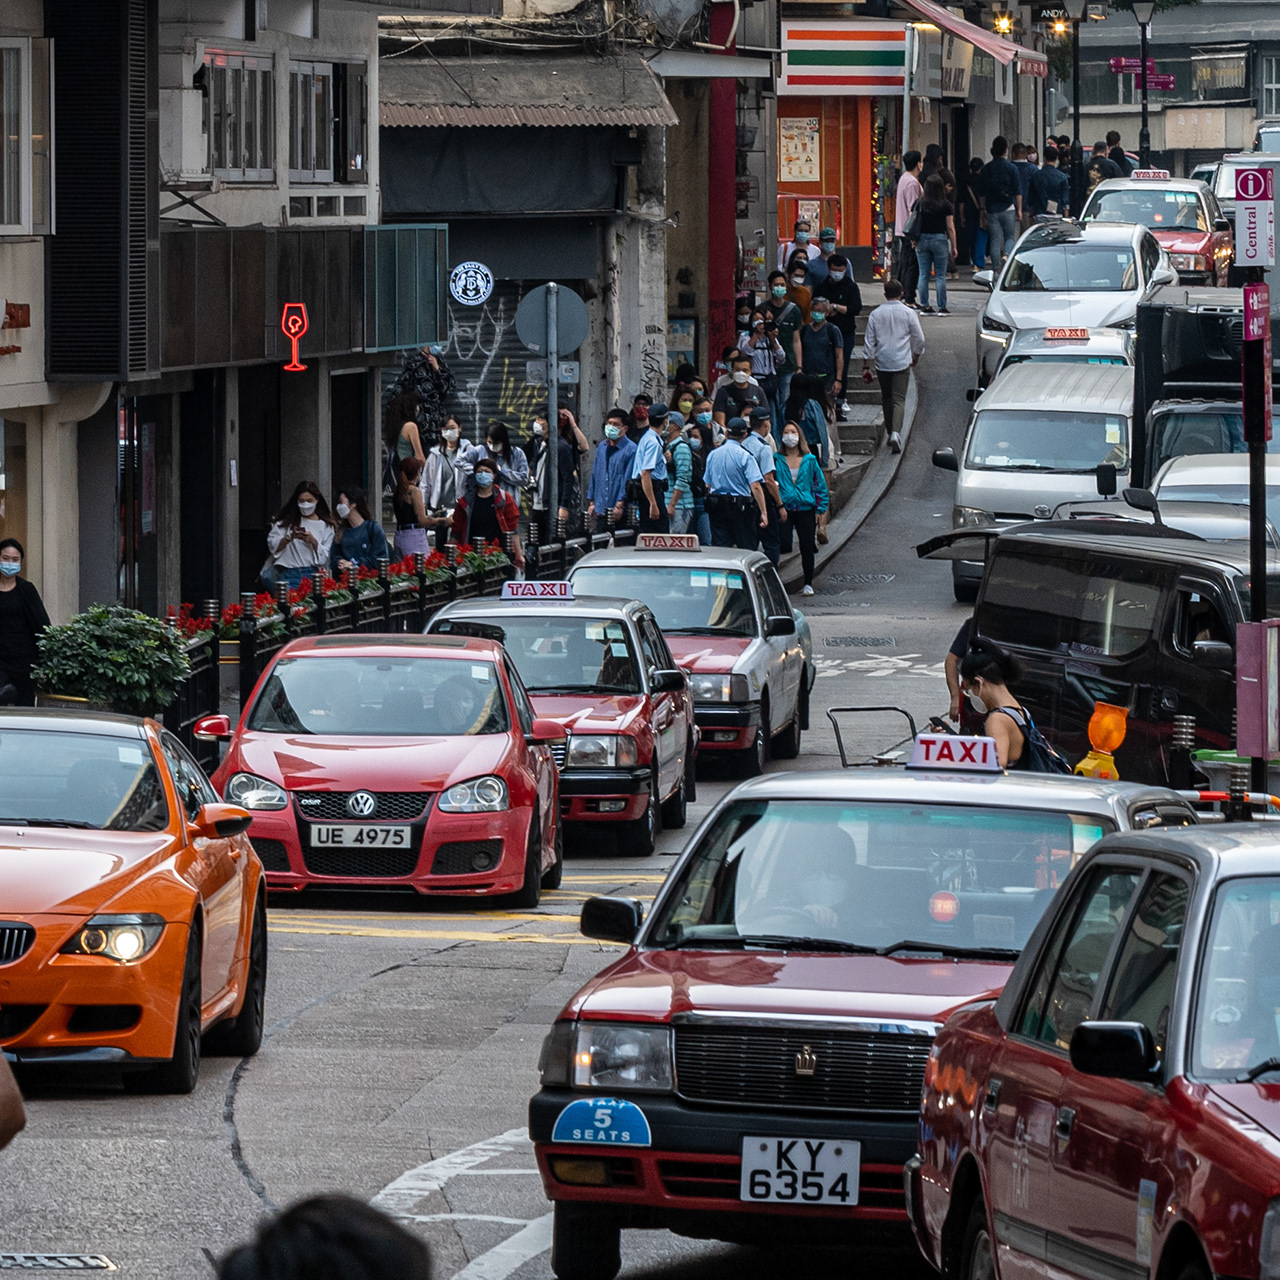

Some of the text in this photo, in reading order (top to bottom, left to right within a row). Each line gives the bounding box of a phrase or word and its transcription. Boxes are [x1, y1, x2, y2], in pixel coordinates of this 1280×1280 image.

[1134, 171, 1167, 179] TAXI
[1244, 205, 1257, 260] Central
[1048, 328, 1086, 338] TAXI
[641, 536, 694, 548] TAXI
[507, 583, 567, 596] TAXI
[919, 739, 988, 763] TAXI
[317, 828, 404, 846] UE 4975
[593, 1108, 612, 1128] 5
[572, 1129, 631, 1141] SEATS
[777, 1140, 826, 1171] KY
[749, 1169, 850, 1203] 6354
